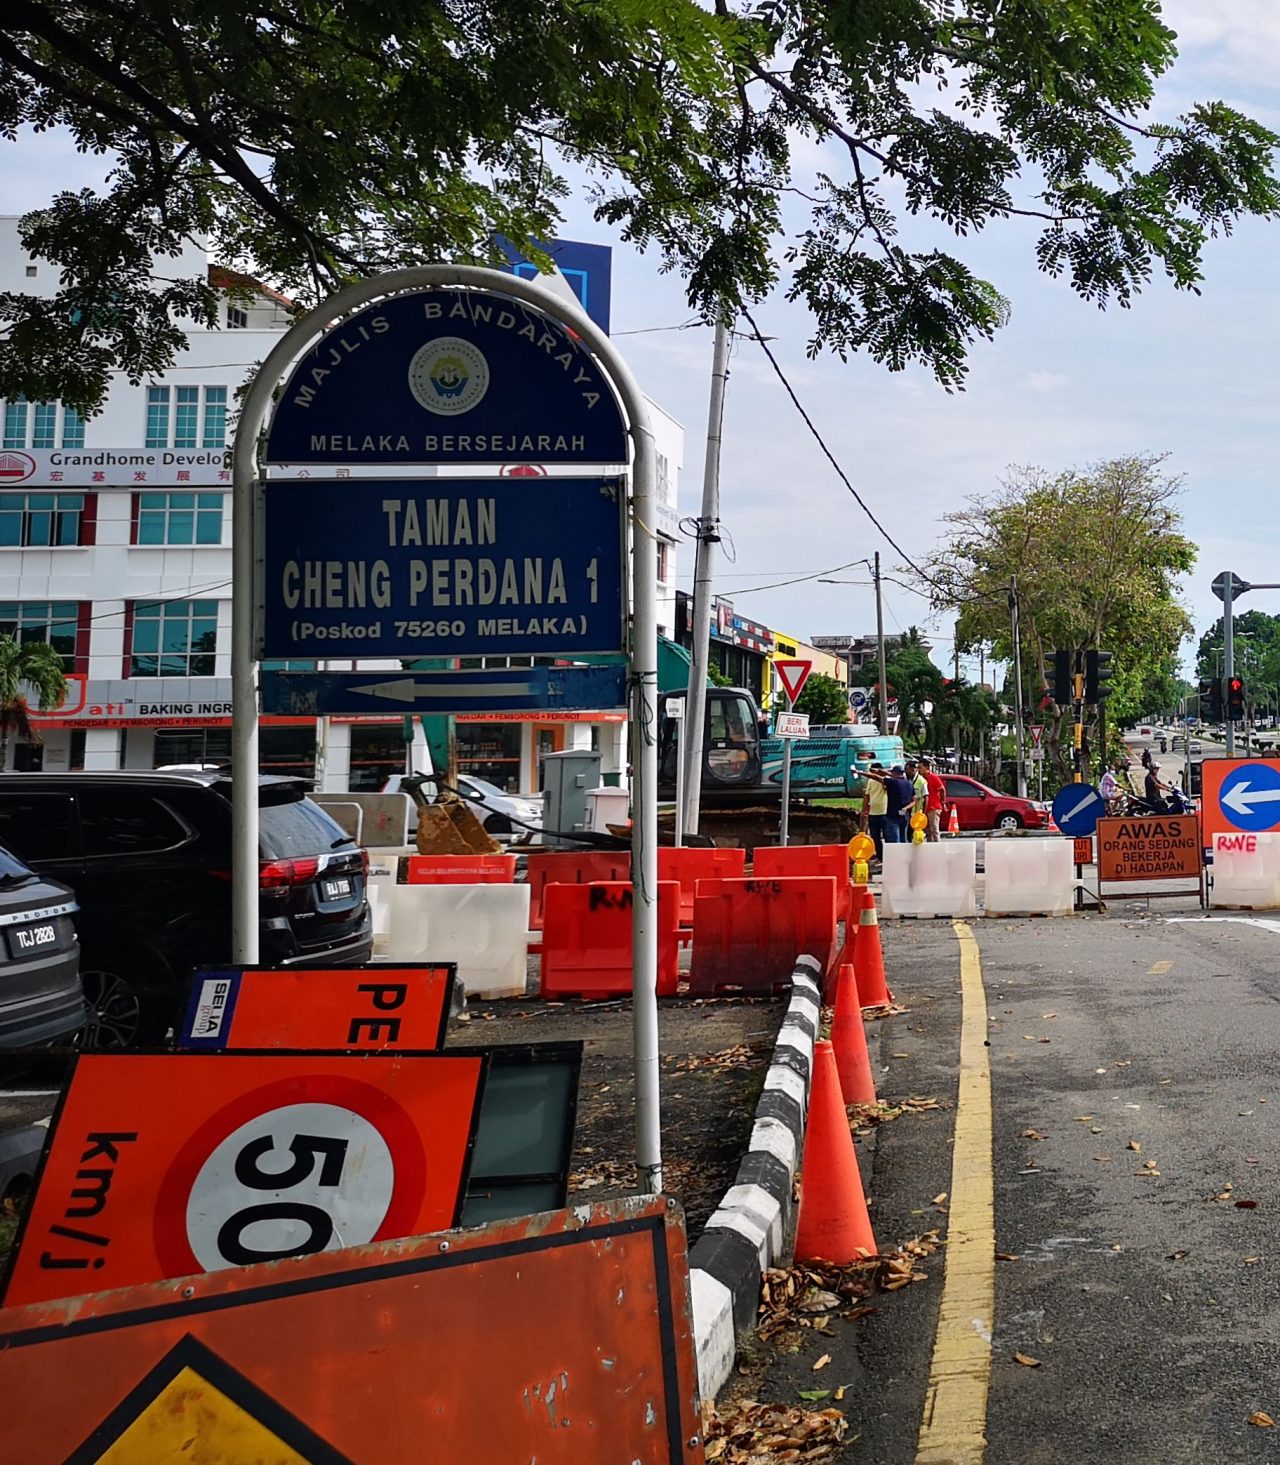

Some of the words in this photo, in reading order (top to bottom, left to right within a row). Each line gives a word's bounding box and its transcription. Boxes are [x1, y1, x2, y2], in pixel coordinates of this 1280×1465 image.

[293, 315, 391, 409] MAJLIS
[424, 301, 601, 410] BANDARAYA
[310, 435, 410, 451] MELAKA
[425, 434, 584, 451] BERSEJARAH
[50, 452, 156, 466] Grandhome
[382, 498, 496, 547] TAMAN
[282, 559, 391, 609] CHENG
[409, 557, 568, 606] PERDANA
[586, 557, 598, 604] 1
[291, 620, 381, 641] (Poskod
[394, 619, 466, 638] 75260
[478, 615, 588, 636] MELAKA)
[140, 704, 193, 715] BAKING
[780, 725, 807, 735] LALUAN
[786, 717, 803, 726] BERI
[1116, 821, 1182, 840] AWAS
[1103, 840, 1146, 851] ORANG
[1148, 838, 1195, 850] SEDANG
[1122, 851, 1176, 862] BEKERJA
[1115, 865, 1127, 874] DI
[1130, 862, 1185, 874] HADAPAN
[12, 906, 68, 921] PROTON
[16, 929, 35, 948] TCJ
[346, 983, 408, 1044] PE
[40, 1131, 138, 1270] km/j
[217, 1133, 350, 1266] 50
